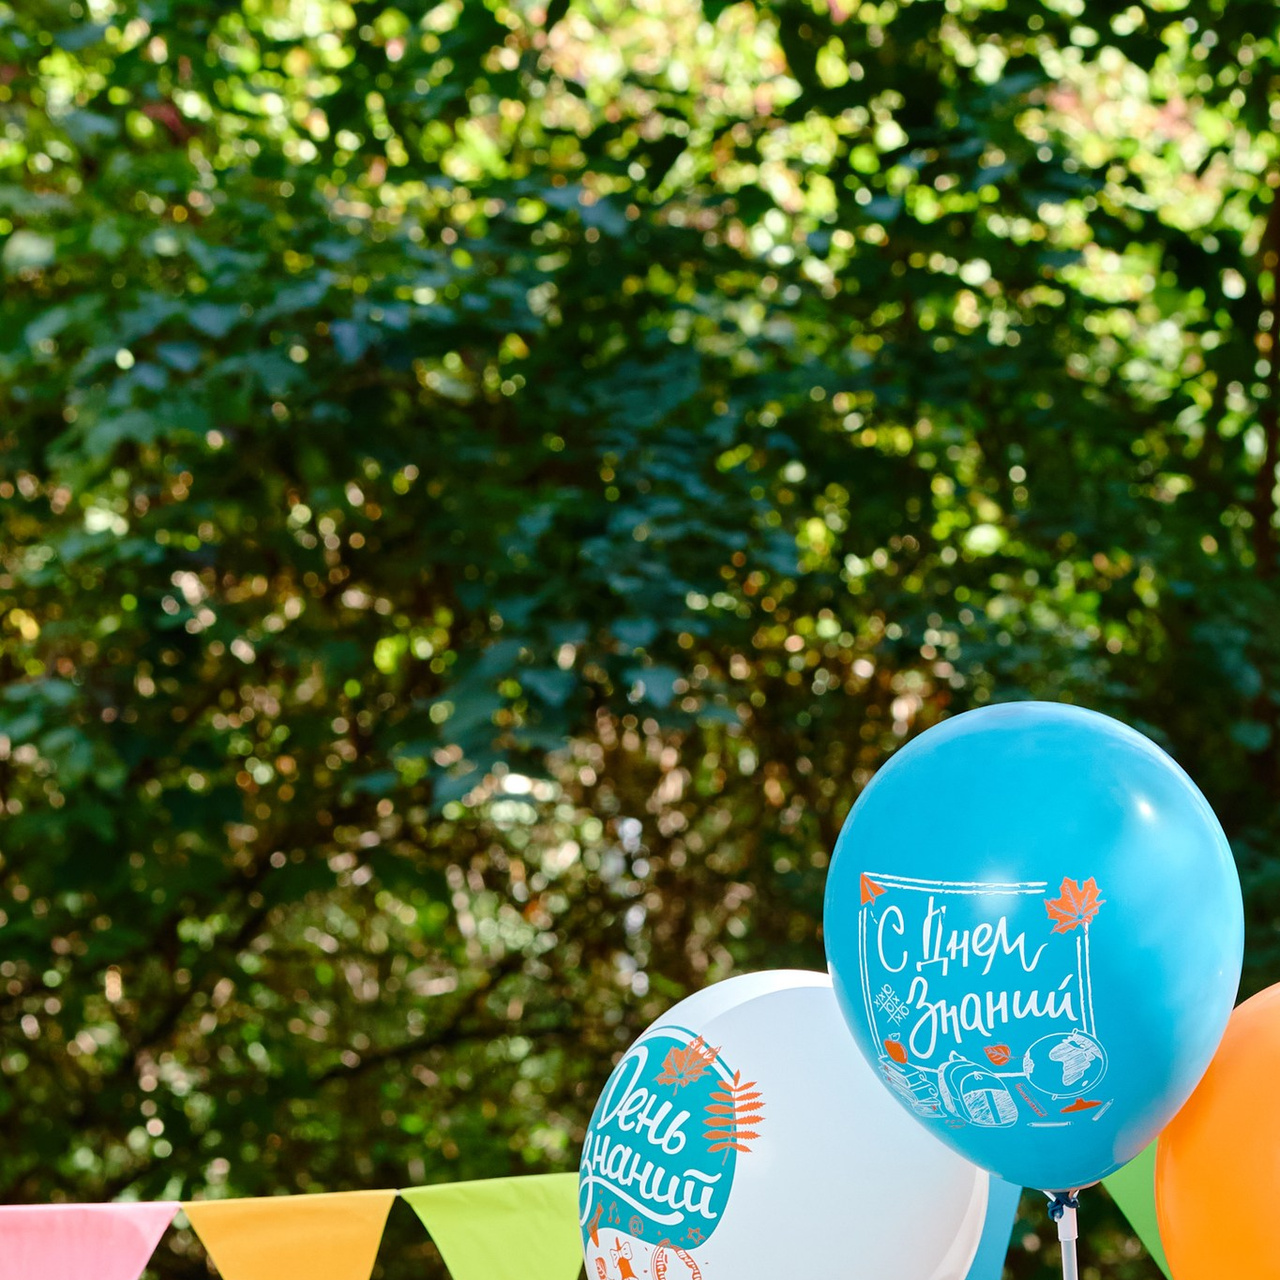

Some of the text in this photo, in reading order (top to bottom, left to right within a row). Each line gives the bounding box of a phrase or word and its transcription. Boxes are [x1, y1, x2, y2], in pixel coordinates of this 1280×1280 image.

[878, 896, 1049, 975] С Днем
[906, 974, 1079, 1059] Знаний
[597, 1045, 691, 1155] День
